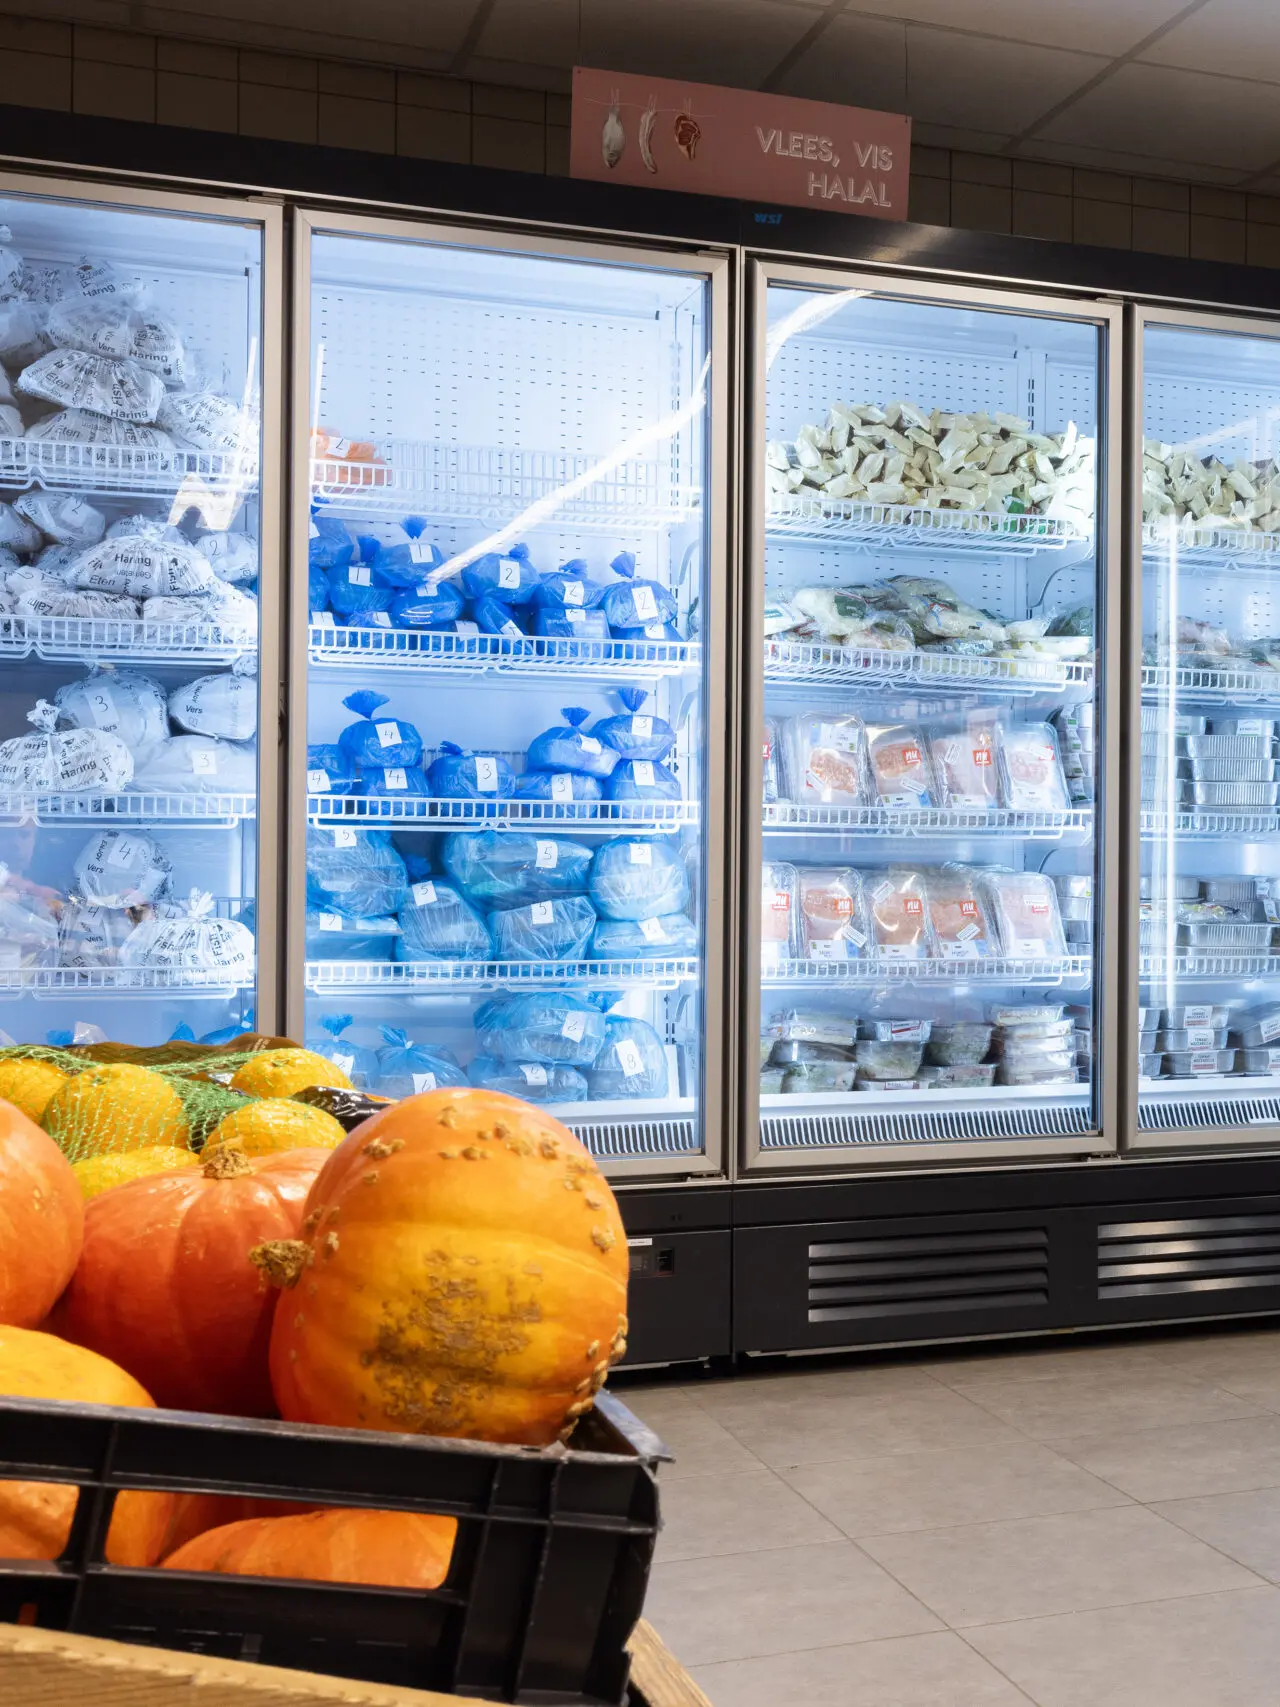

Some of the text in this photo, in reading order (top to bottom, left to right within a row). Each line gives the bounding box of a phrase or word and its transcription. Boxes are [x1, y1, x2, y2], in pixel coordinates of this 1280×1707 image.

[756, 126, 892, 171] VLEES, VIS
[808, 172, 891, 207] HALAL
[129, 350, 169, 362] Haring
[110, 409, 148, 420] Haring
[505, 568, 514, 582] 2
[95, 695, 108, 712] 3
[60, 760, 97, 780] Haring
[388, 771, 404, 783] 4
[483, 764, 492, 779] 3
[558, 778, 565, 792] 3
[119, 841, 132, 860] 4
[543, 846, 552, 860] 5
[87, 863, 104, 873] Vers
